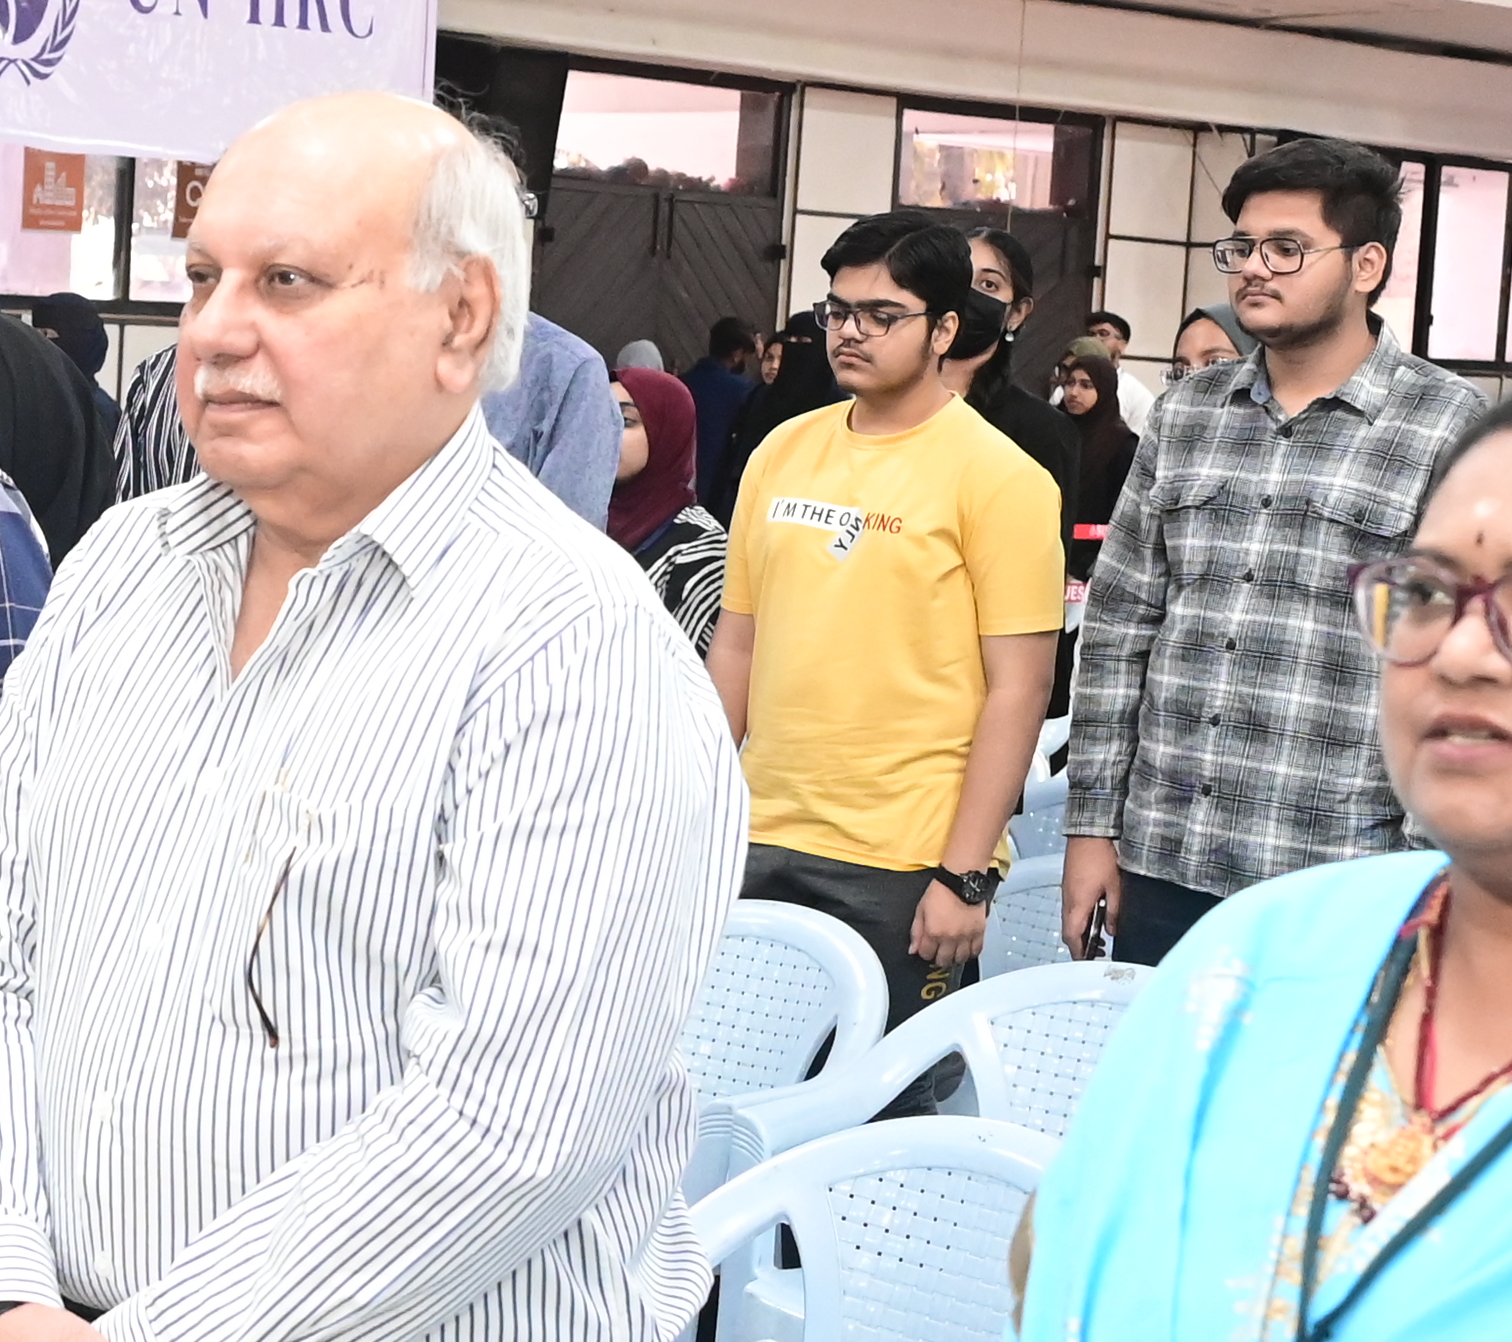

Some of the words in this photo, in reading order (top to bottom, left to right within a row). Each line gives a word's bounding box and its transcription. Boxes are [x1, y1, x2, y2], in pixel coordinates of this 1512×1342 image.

[772, 499, 797, 518] I'M
[801, 504, 836, 525] THE
[862, 512, 903, 534] KING
